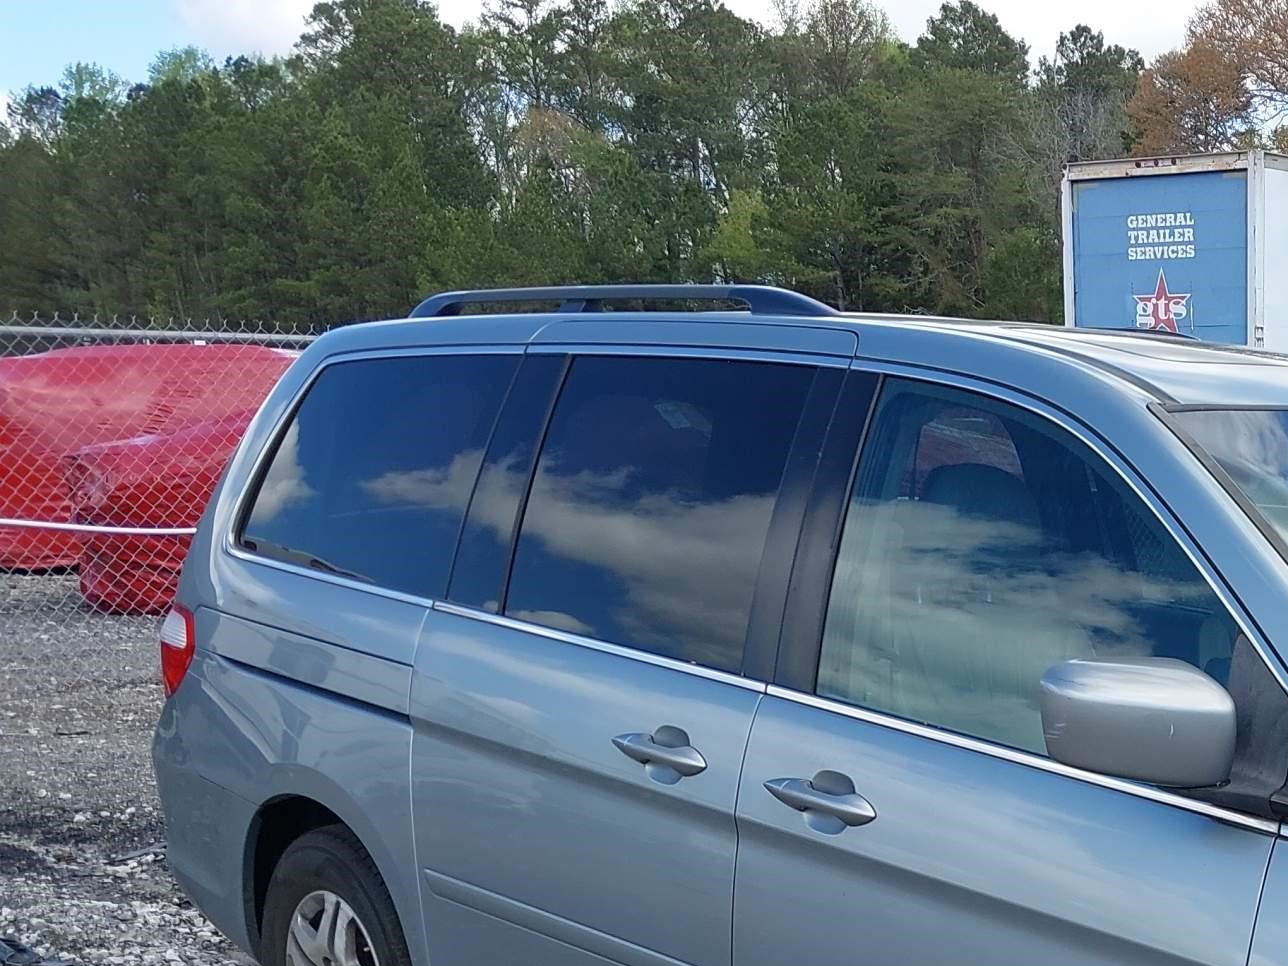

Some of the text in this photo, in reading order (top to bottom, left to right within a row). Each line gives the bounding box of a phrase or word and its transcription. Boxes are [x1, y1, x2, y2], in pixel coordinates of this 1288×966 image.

[1127, 212, 1195, 228] GENERAL
[1128, 228, 1194, 244] TRAILER
[1128, 245, 1195, 260] SERVICES
[1136, 295, 1187, 328] gts
